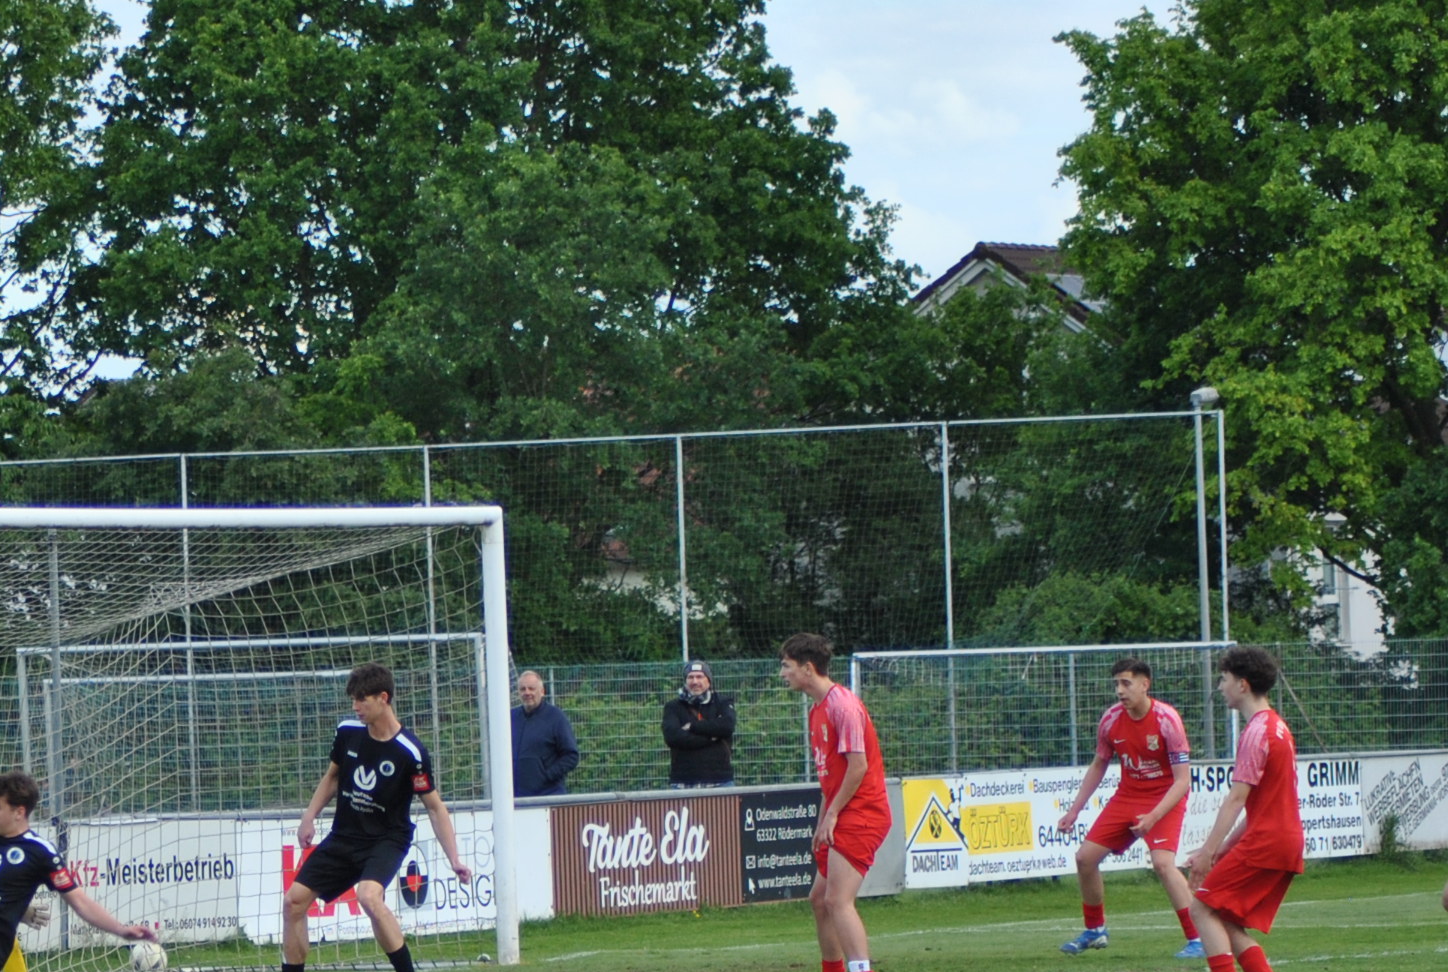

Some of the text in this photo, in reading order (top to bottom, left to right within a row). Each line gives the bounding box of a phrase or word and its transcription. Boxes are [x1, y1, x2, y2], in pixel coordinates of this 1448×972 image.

[1308, 761, 1359, 787] GRIMM
[969, 780, 1025, 797] Dachdeckerei
[1033, 777, 1081, 795] Bauspengler
[1298, 793, 1337, 809] er-Röder
[1339, 792, 1353, 806] Str.
[755, 804, 817, 821] Odenwaldstraße 80
[756, 825, 813, 842] 63322 Rödermark
[969, 806, 1031, 850] ÖZTÜRK
[1302, 814, 1362, 834] ppertshausen
[582, 806, 710, 873] Tante Ela
[757, 851, 812, 869] info@tanteela.de
[912, 850, 959, 873] DACHTEAM
[70, 853, 235, 888] Kfz-Meisterbetrieb
[758, 872, 812, 889] www.tanteela.de
[600, 865, 697, 908] Frischemarkt
